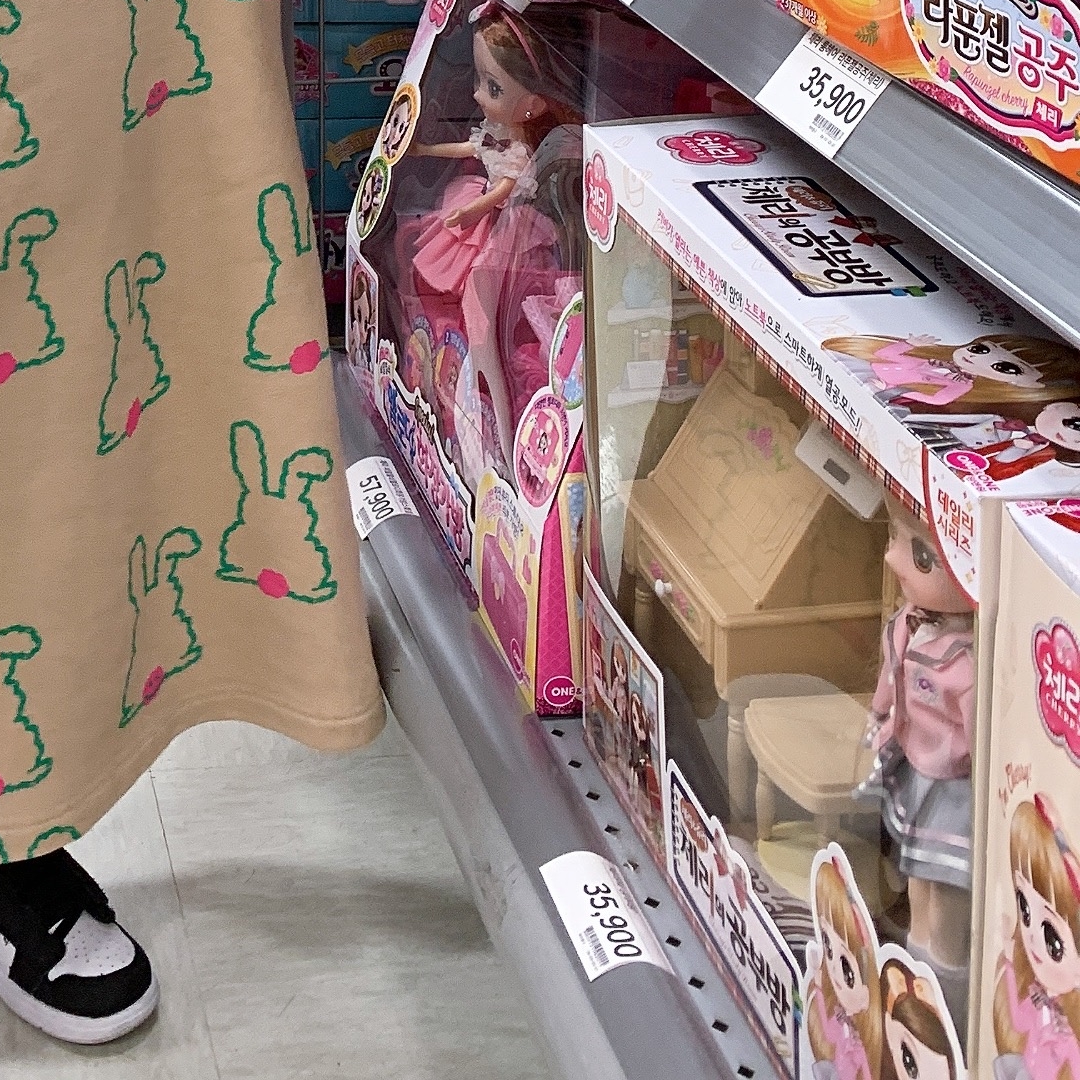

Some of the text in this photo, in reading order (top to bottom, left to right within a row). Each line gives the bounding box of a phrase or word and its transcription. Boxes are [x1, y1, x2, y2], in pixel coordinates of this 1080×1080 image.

[962, 64, 1001, 100] Rapunzel
[1013, 24, 1080, 103] 공주
[799, 66, 867, 125] 35,900
[1035, 102, 1060, 128] 체리
[693, 135, 740, 159] 체리
[588, 176, 608, 216] 체리
[740, 185, 806, 229] 체리의
[784, 226, 894, 288] 공부방
[743, 297, 783, 340] 노트북으로
[782, 331, 824, 381] 스마트하게
[824, 375, 861, 431] 열공모드!
[358, 474, 395, 520] 57,900
[937, 489, 975, 535] 데일리
[937, 518, 975, 560] 시리즈
[582, 882, 643, 959] 35,900
[727, 898, 793, 1036] 공부방
